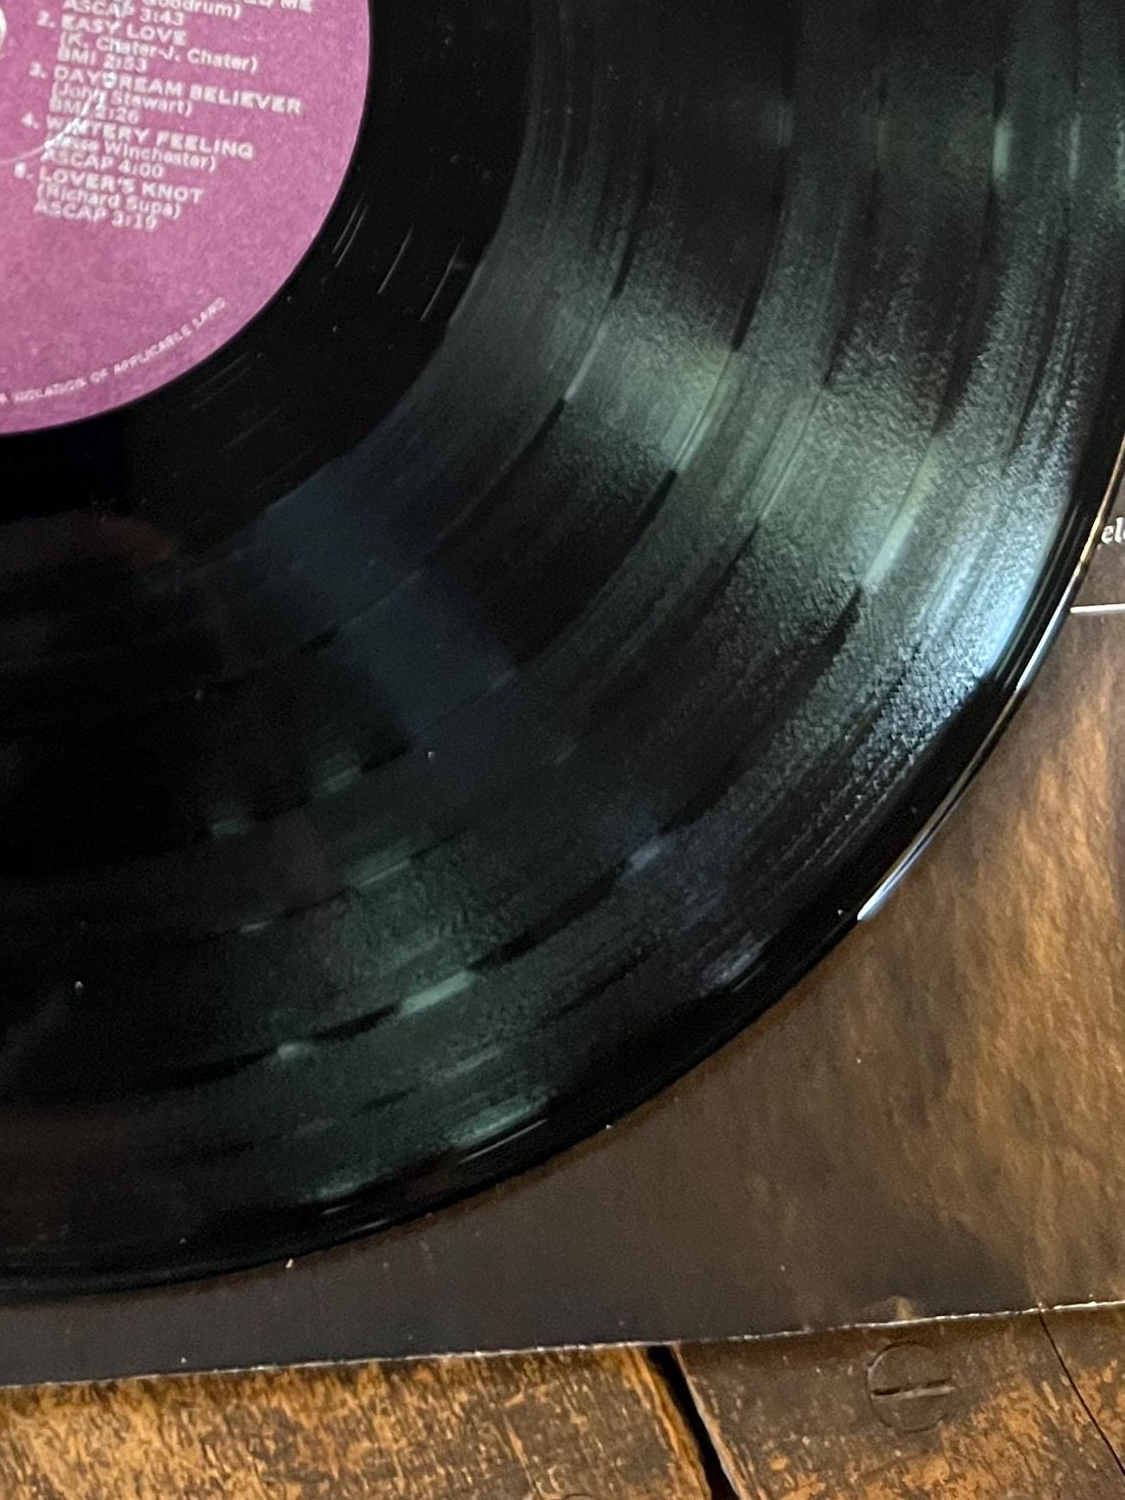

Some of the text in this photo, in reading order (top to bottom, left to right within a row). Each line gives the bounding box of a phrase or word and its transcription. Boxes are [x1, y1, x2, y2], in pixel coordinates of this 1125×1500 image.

[37, 9, 186, 46] 2. EASY LOVE
[139, 7, 185, 26] 3:43
[57, 47, 96, 67] BMI
[60, 30, 88, 49] (K.
[187, 48, 258, 73] Chater)
[54, 63, 183, 97] DAYDREAM
[189, 83, 303, 115] BELIEVER
[110, 90, 192, 117] Stewart)
[104, 140, 216, 173] Winchester)
[156, 130, 255, 160] FEELING
[119, 159, 164, 179] 4:00
[39, 166, 205, 204] LOVER'S KNOT
[33, 200, 108, 221] ASCAP
[37, 183, 182, 220] (Richard Supa)
[90, 368, 108, 384] OF
